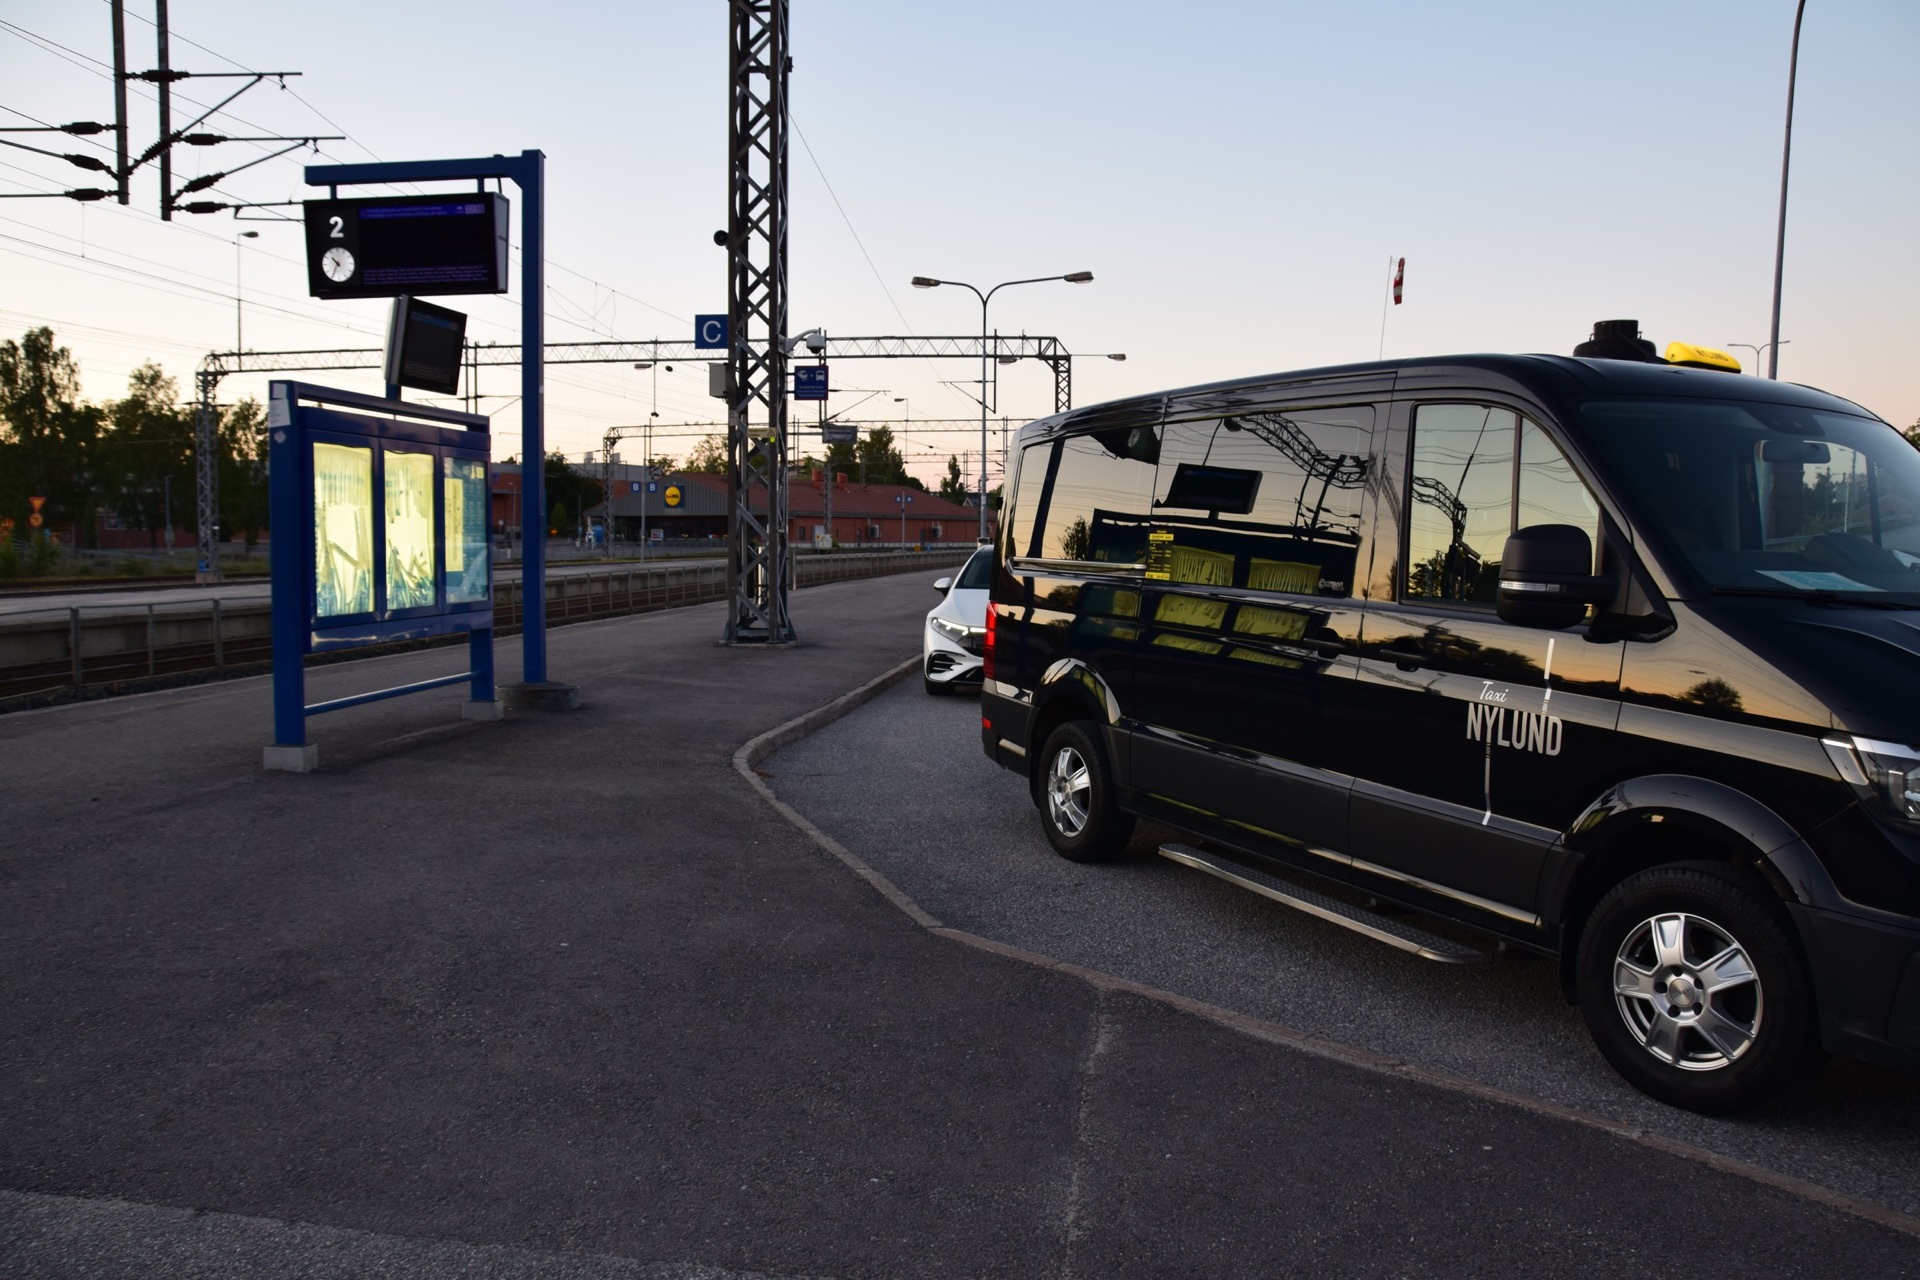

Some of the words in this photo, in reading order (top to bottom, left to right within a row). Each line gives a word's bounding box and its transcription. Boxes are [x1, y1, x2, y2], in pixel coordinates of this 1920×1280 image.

[329, 216, 345, 238] 2
[702, 320, 722, 343] C
[633, 483, 639, 491] B
[649, 483, 656, 491] B
[1479, 681, 1509, 702] Taxi
[1466, 702, 1563, 756] NYLUND
